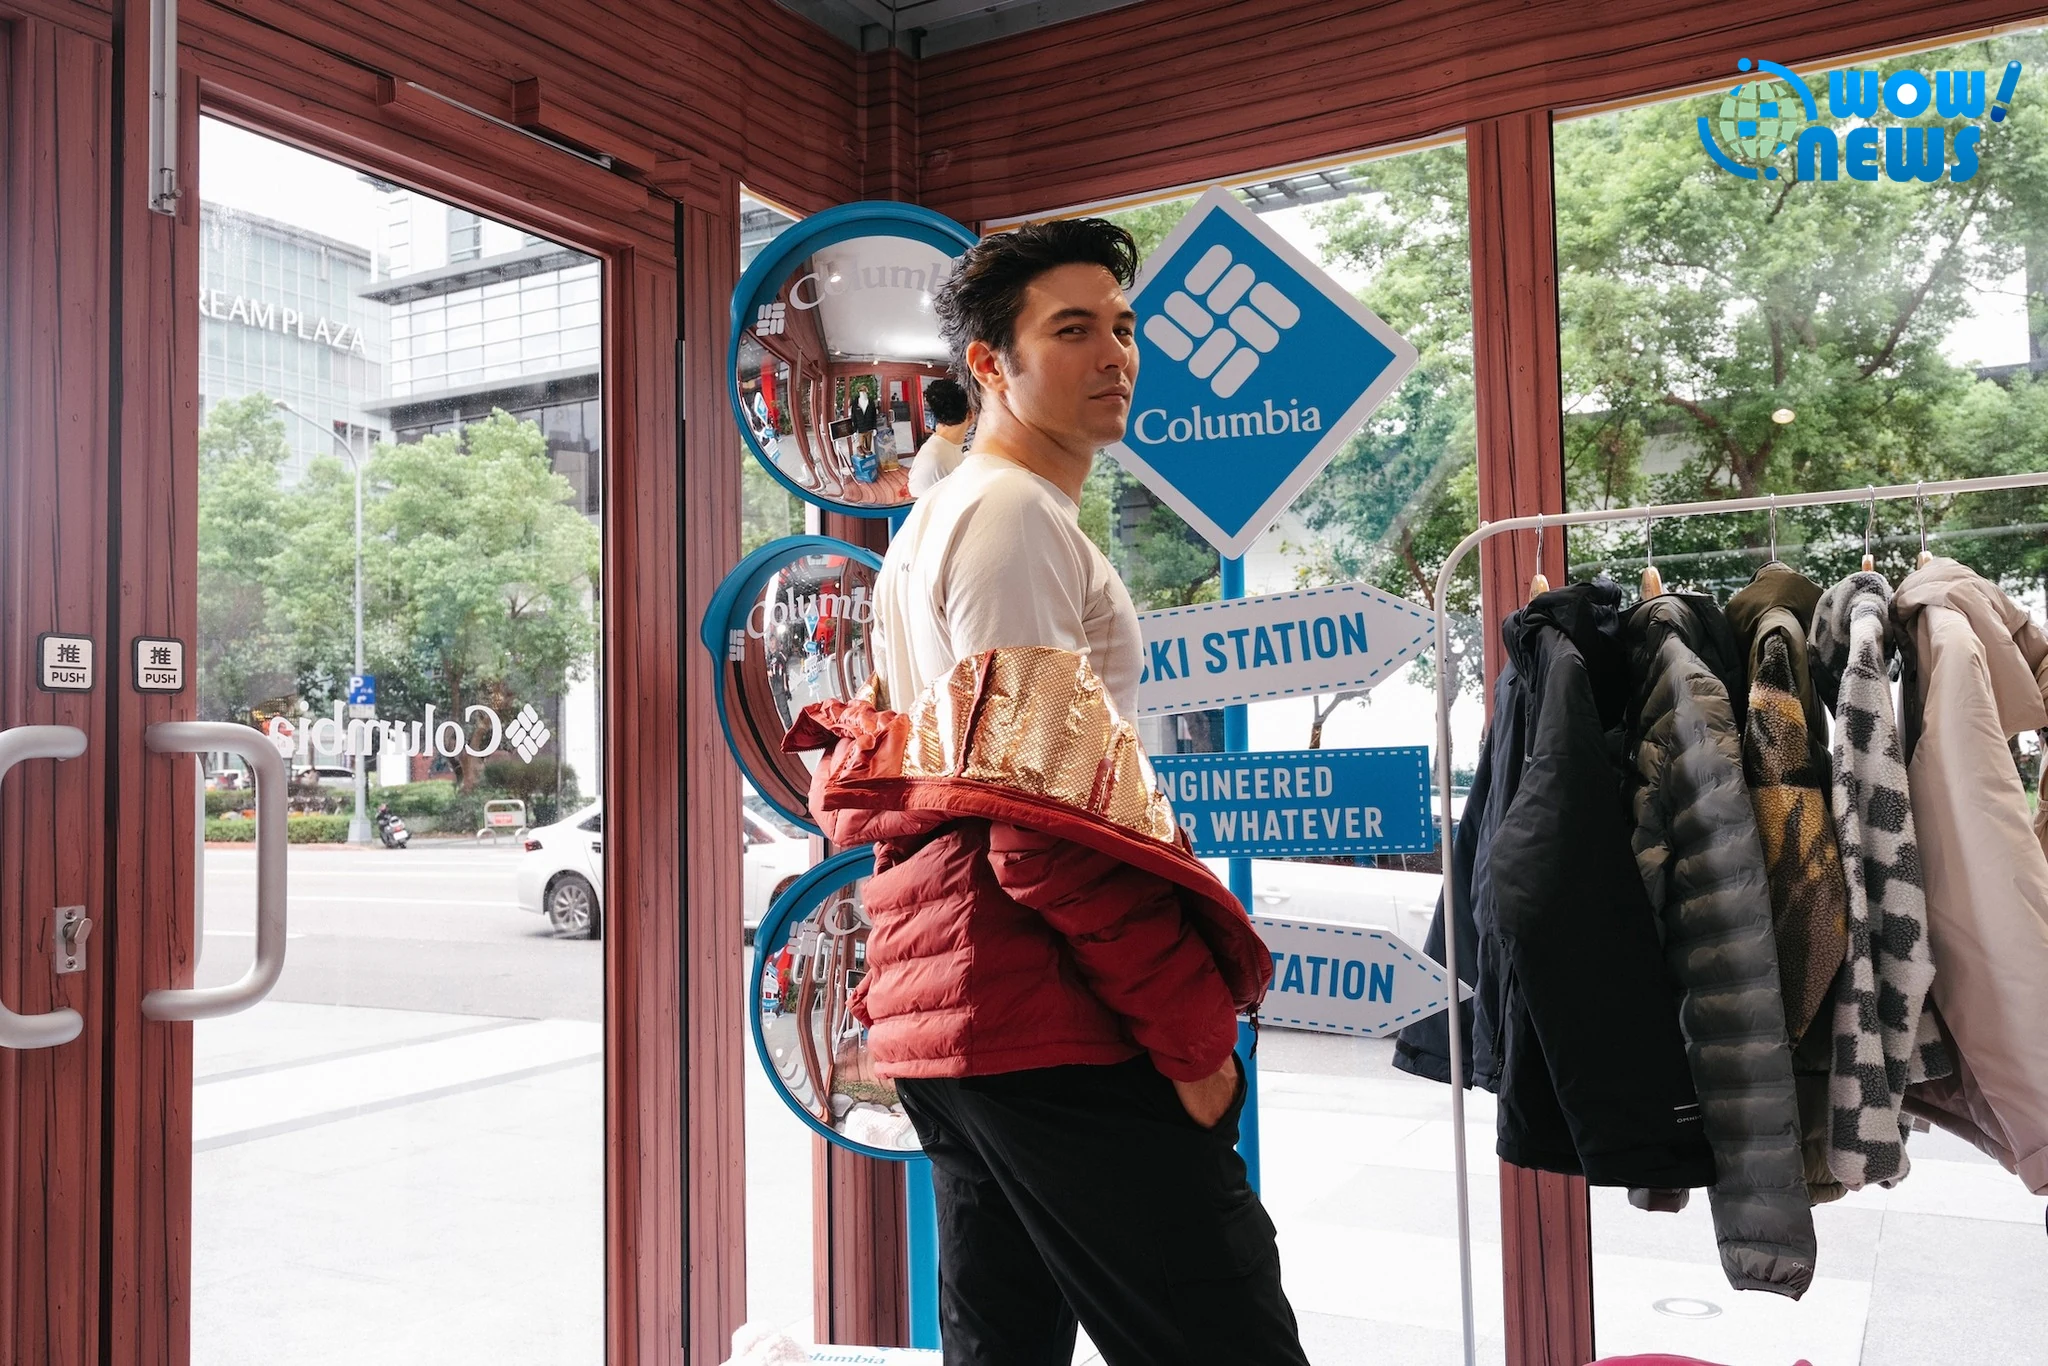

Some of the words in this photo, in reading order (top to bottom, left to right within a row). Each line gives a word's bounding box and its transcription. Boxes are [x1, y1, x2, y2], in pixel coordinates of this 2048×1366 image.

[789, 254, 951, 310] Columb
[199, 288, 275, 331] REAM
[281, 307, 366, 354] PLAZA
[1134, 399, 1321, 444] Columbia
[746, 586, 874, 639] Columb
[57, 643, 81, 664] 推
[150, 646, 172, 665] 推
[1202, 612, 1368, 674] STATION
[52, 671, 85, 683] PUSH
[146, 673, 176, 684] PUSH
[1158, 766, 1333, 802] NGINEERED
[1210, 807, 1384, 843] WHATEVER
[1268, 951, 1395, 1004] TATION
